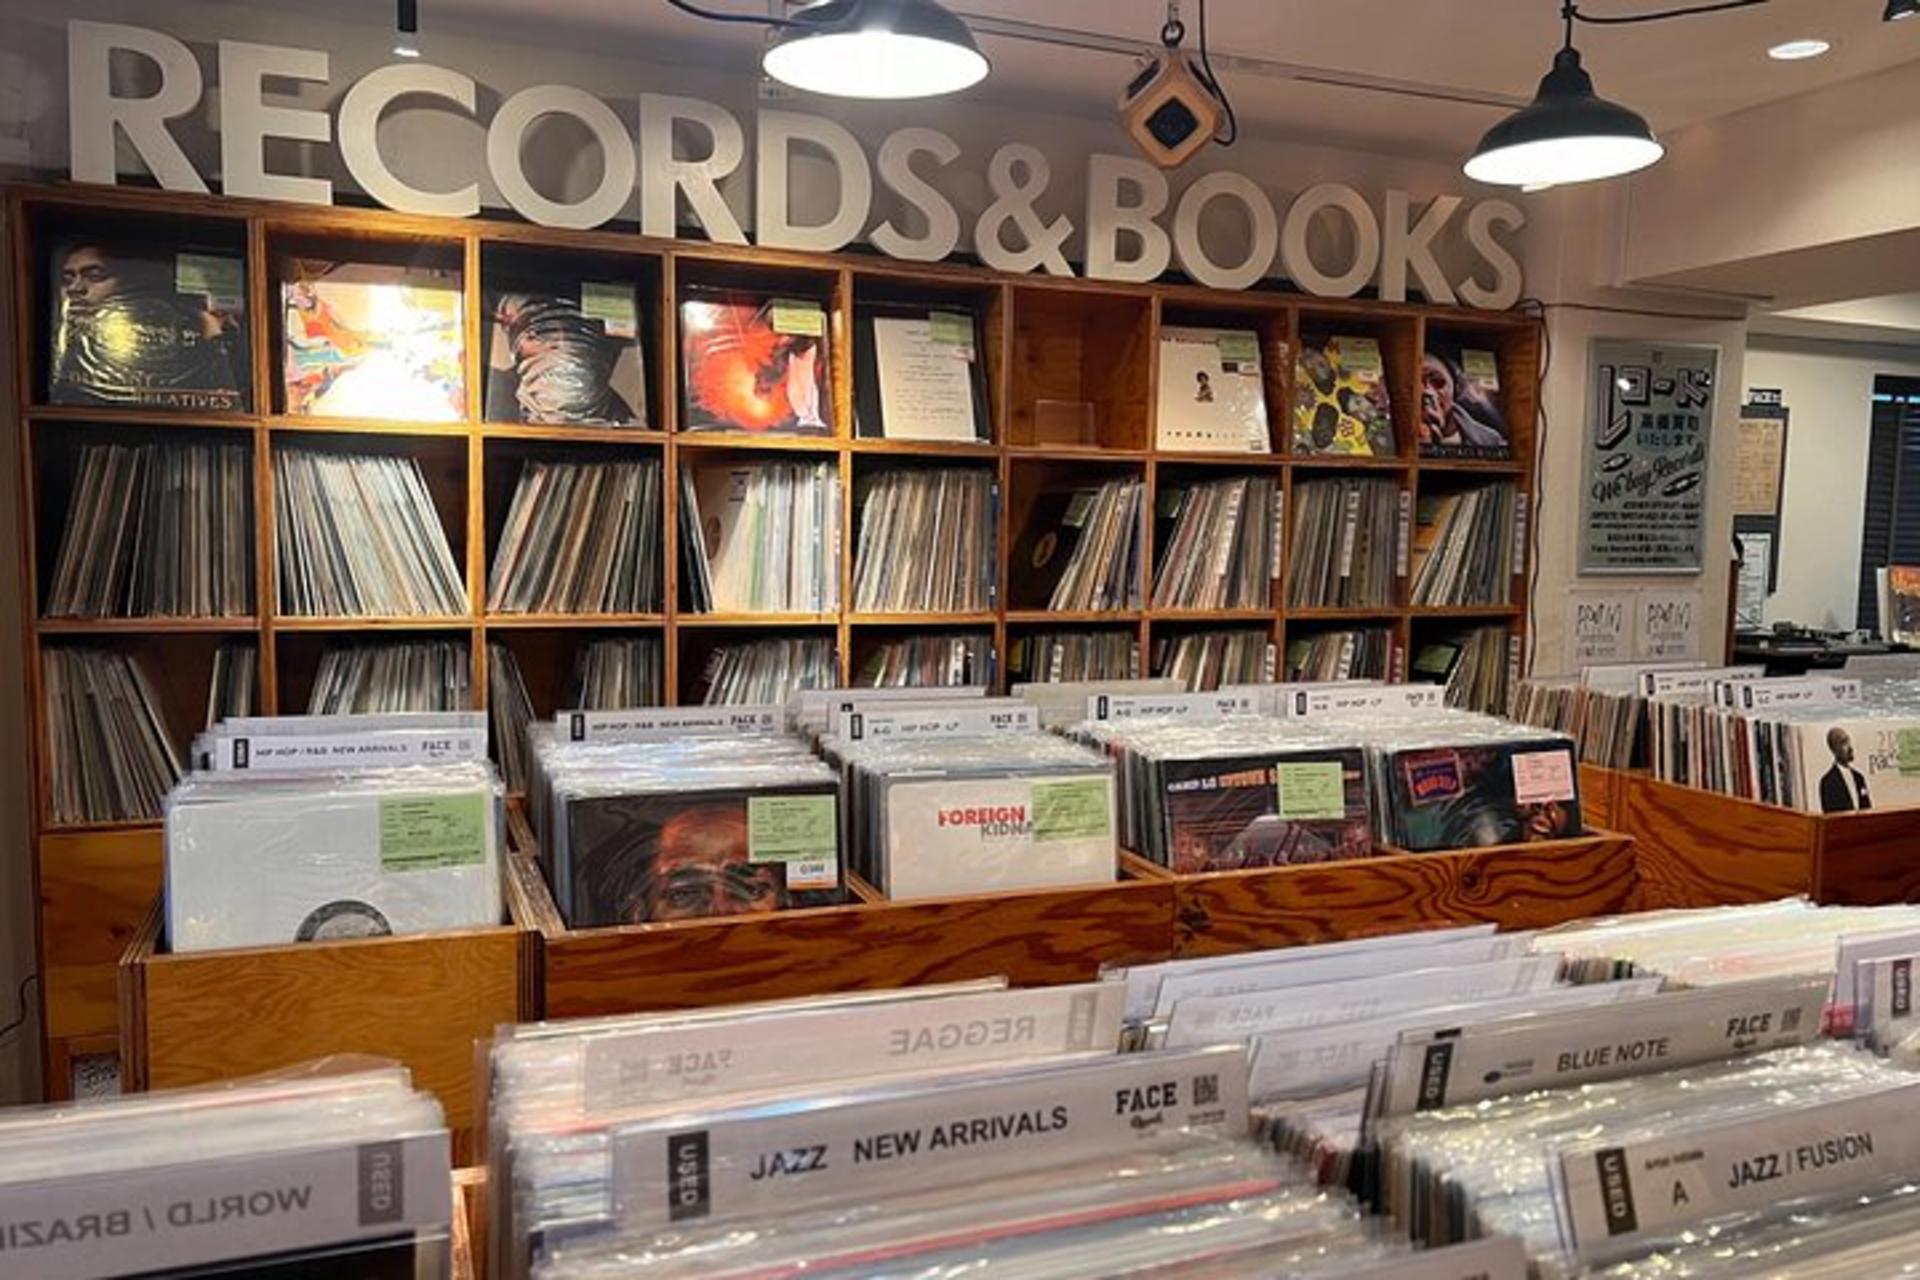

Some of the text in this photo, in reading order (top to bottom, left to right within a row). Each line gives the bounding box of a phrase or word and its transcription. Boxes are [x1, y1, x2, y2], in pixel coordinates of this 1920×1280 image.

[938, 805, 1025, 827] FOREIGN
[1726, 1013, 1771, 1037] FACE
[1557, 1045, 1611, 1072] BLUE
[1615, 1037, 1669, 1062] NOTE
[1116, 1081, 1178, 1115] FACE
[750, 1106, 1068, 1180] JAZZ NEW ARRIVALS
[1729, 1154, 1782, 1188] JAZZ
[1796, 1132, 1873, 1171] FUSION
[676, 1143, 699, 1206] USED
[1603, 1156, 1627, 1219] USED
[1673, 1180, 1690, 1206] A
